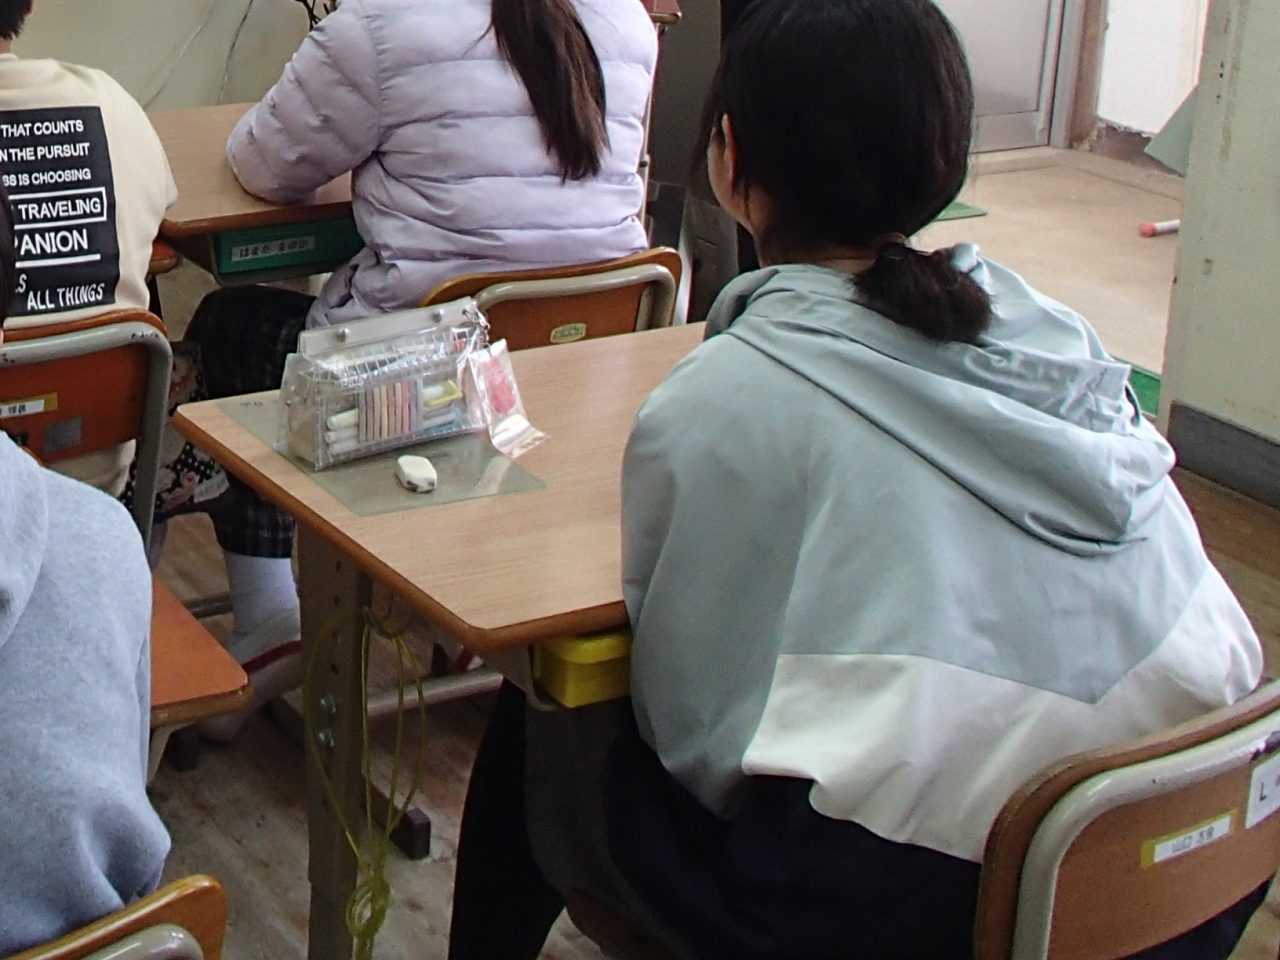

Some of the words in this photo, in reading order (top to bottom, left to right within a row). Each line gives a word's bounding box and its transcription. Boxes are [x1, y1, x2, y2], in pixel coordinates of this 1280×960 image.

[0, 123, 32, 138] THAT
[33, 120, 84, 135] COUNTS
[9, 147, 36, 161] THE
[37, 143, 90, 159] PURSUIT
[19, 173, 30, 186] IS
[31, 168, 92, 185] CHOOSING
[18, 197, 101, 220] TRAVELING
[14, 228, 88, 256] ANION
[27, 289, 55, 311] ALL
[57, 283, 106, 307] THINGS
